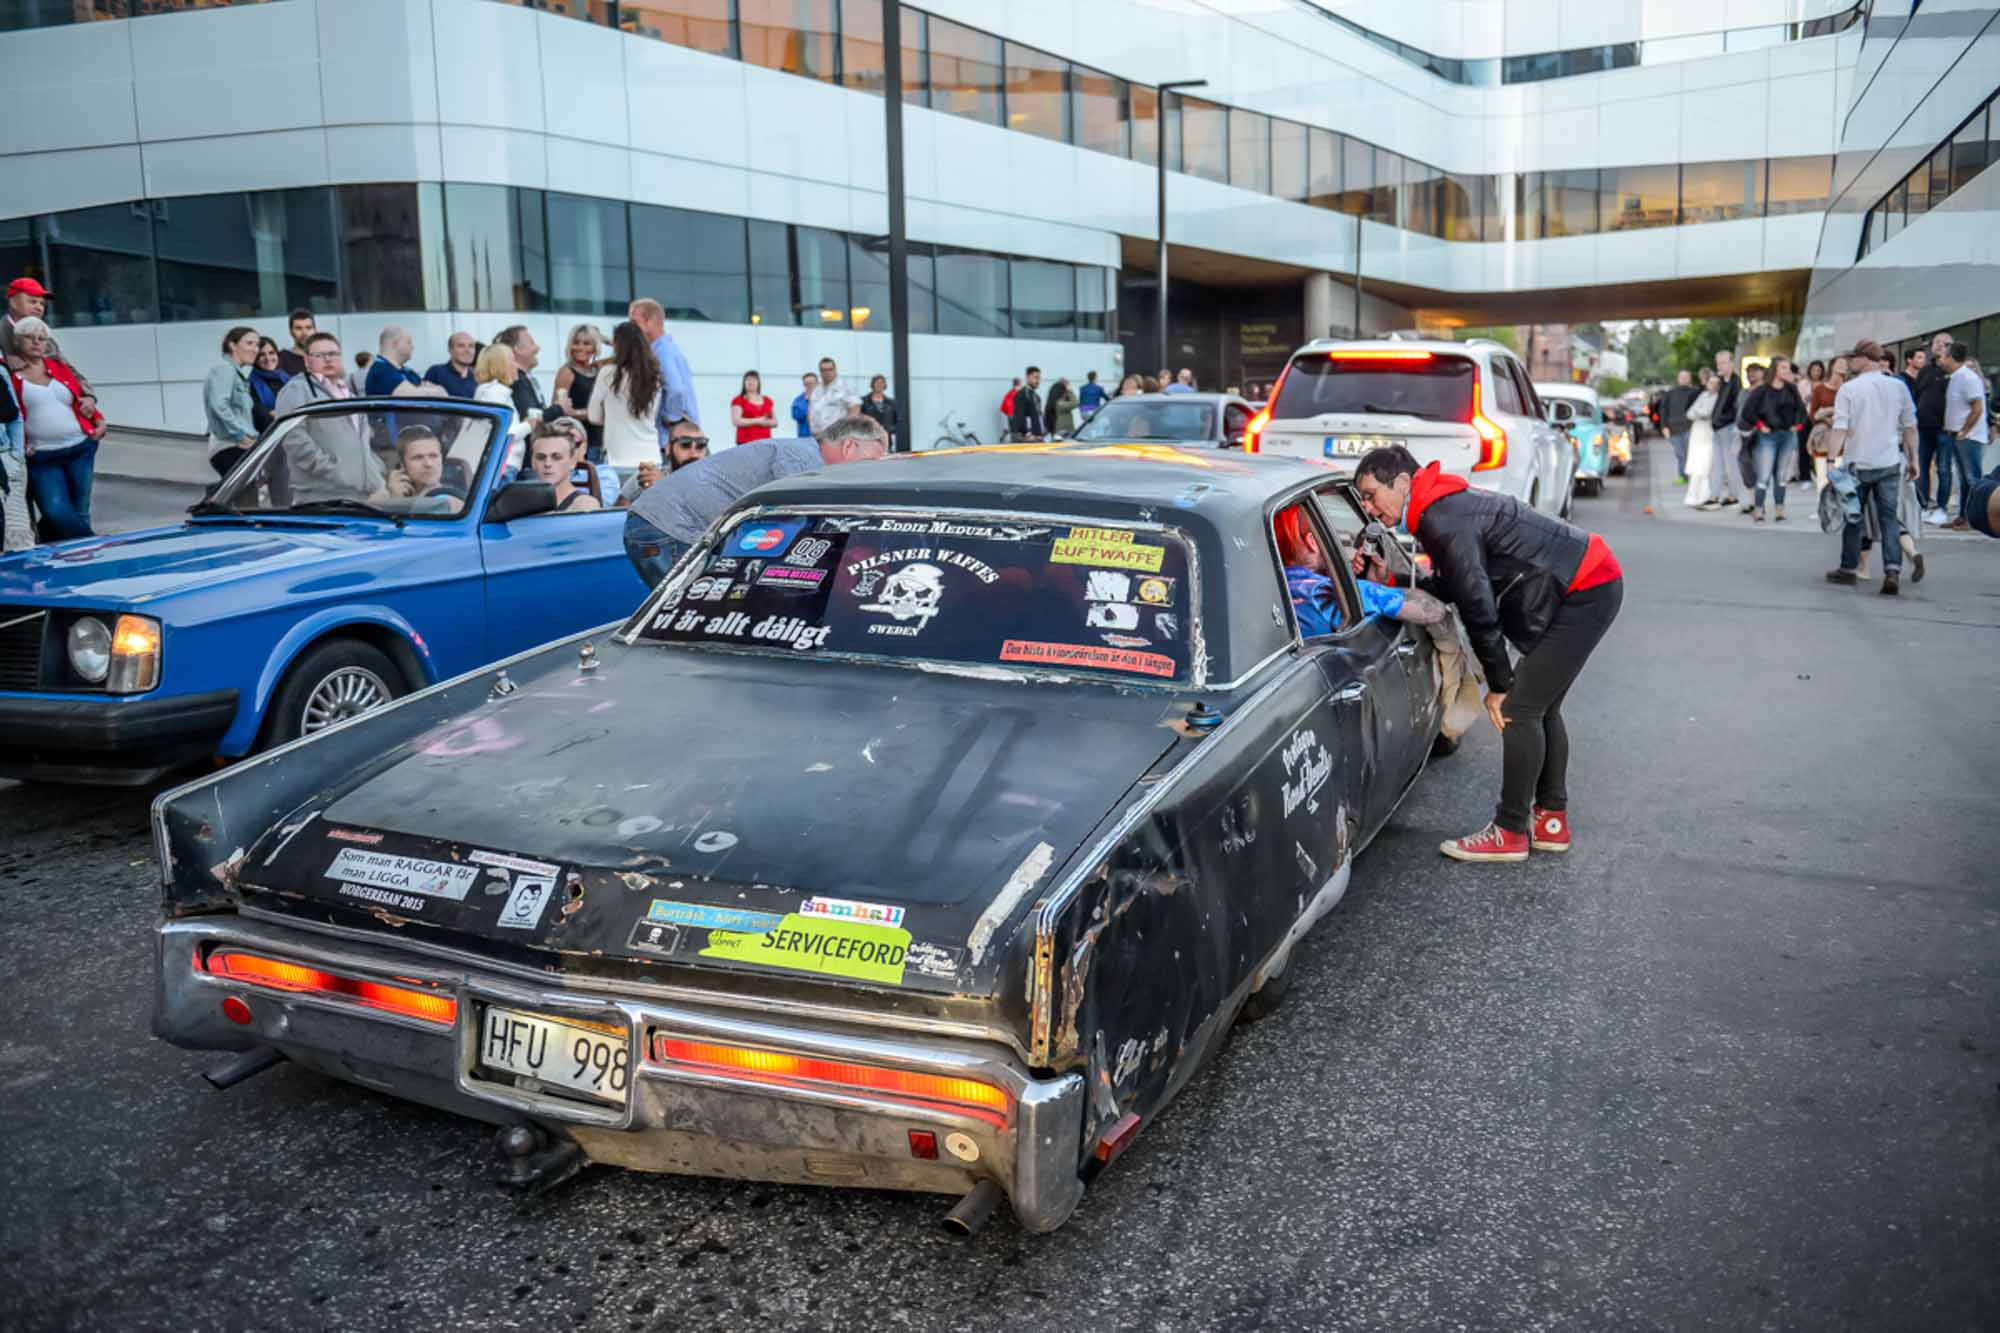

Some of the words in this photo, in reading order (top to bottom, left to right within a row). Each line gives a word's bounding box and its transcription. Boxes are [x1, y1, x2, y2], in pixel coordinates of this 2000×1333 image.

[879, 519, 929, 533] EDDIE
[928, 521, 993, 536] MEDUZA
[1071, 527, 1132, 543] HITLER
[847, 548, 931, 577] PILSNER
[936, 549, 1000, 585] WAFFES
[1054, 545, 1158, 565] LUFTWAFFE
[652, 608, 677, 630] vi
[674, 610, 706, 631] är
[705, 611, 750, 636] allt
[752, 615, 832, 650] dåligt
[867, 624, 920, 637] SWEDEN
[340, 851, 365, 863] Som
[366, 856, 392, 868] man
[395, 859, 454, 878] RAGGAR
[455, 867, 474, 882] får
[341, 867, 367, 879] man
[368, 870, 410, 887] LIGGA
[338, 883, 403, 907] NORGERESAN
[401, 895, 426, 912] 2015
[802, 899, 902, 923] samhall
[761, 928, 907, 966] SERVICEFORD
[488, 1015, 548, 1069] HFU
[573, 1037, 627, 1092] 998
